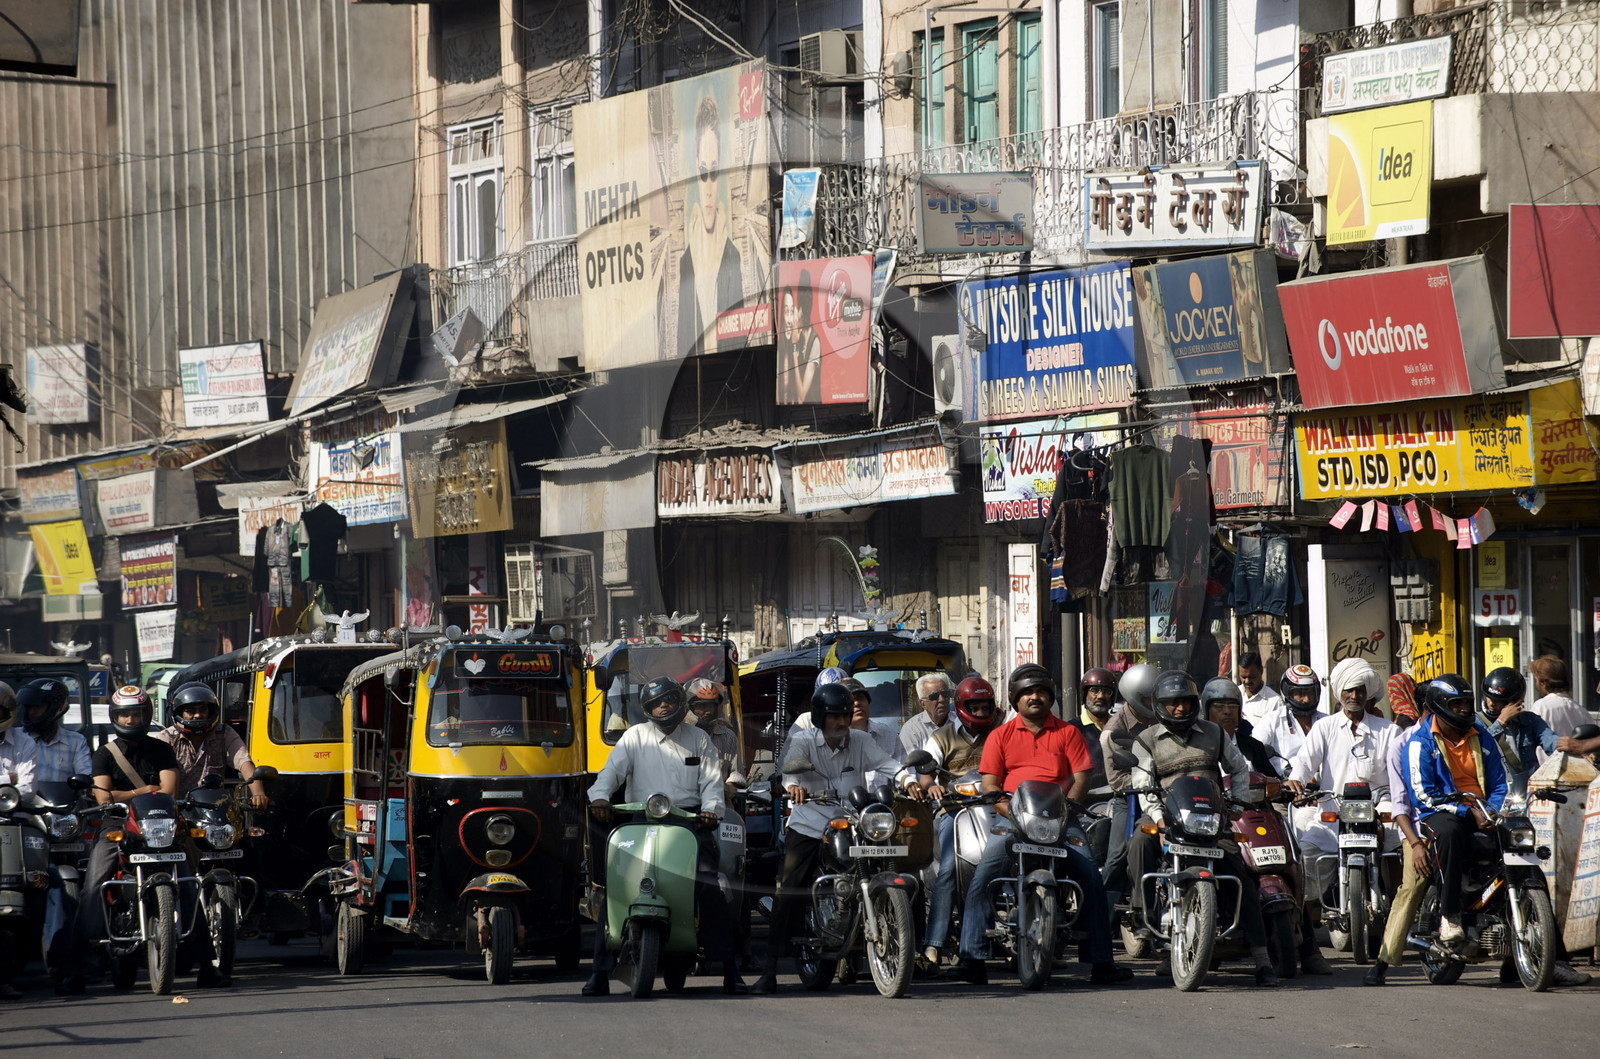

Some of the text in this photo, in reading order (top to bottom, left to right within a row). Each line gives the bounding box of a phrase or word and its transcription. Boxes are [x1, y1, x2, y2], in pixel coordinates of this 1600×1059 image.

[1350, 40, 1448, 76] SHELTER TO SUFFERINGS
[1353, 77, 1392, 101] असहाय
[1395, 73, 1413, 97] पशु
[585, 181, 640, 228] MEHTA
[586, 242, 644, 289] OPTICS
[844, 301, 862, 316] mobile
[976, 268, 1134, 344] MYSORE SILK HOUSE
[718, 314, 739, 335] CHANGE
[1170, 305, 1234, 344] JOCKEY
[1343, 316, 1429, 357] vodafone
[1026, 342, 1084, 372] DESIGNER
[1404, 363, 1414, 374] Walk
[1419, 362, 1428, 373] Talk
[981, 363, 1134, 417] SAREES & SALWAR SUITS
[1509, 401, 1525, 420] पर
[1304, 415, 1378, 454] WALK-IN
[1378, 409, 1457, 448] TALK-IN
[883, 450, 905, 475] राज
[659, 454, 769, 503] INDIA AGENCIES
[1034, 479, 1047, 493] The
[985, 499, 1039, 522] MYSORE
[1226, 489, 1265, 504] Garments
[1482, 594, 1516, 617] STD
[1333, 637, 1379, 662] EURO
